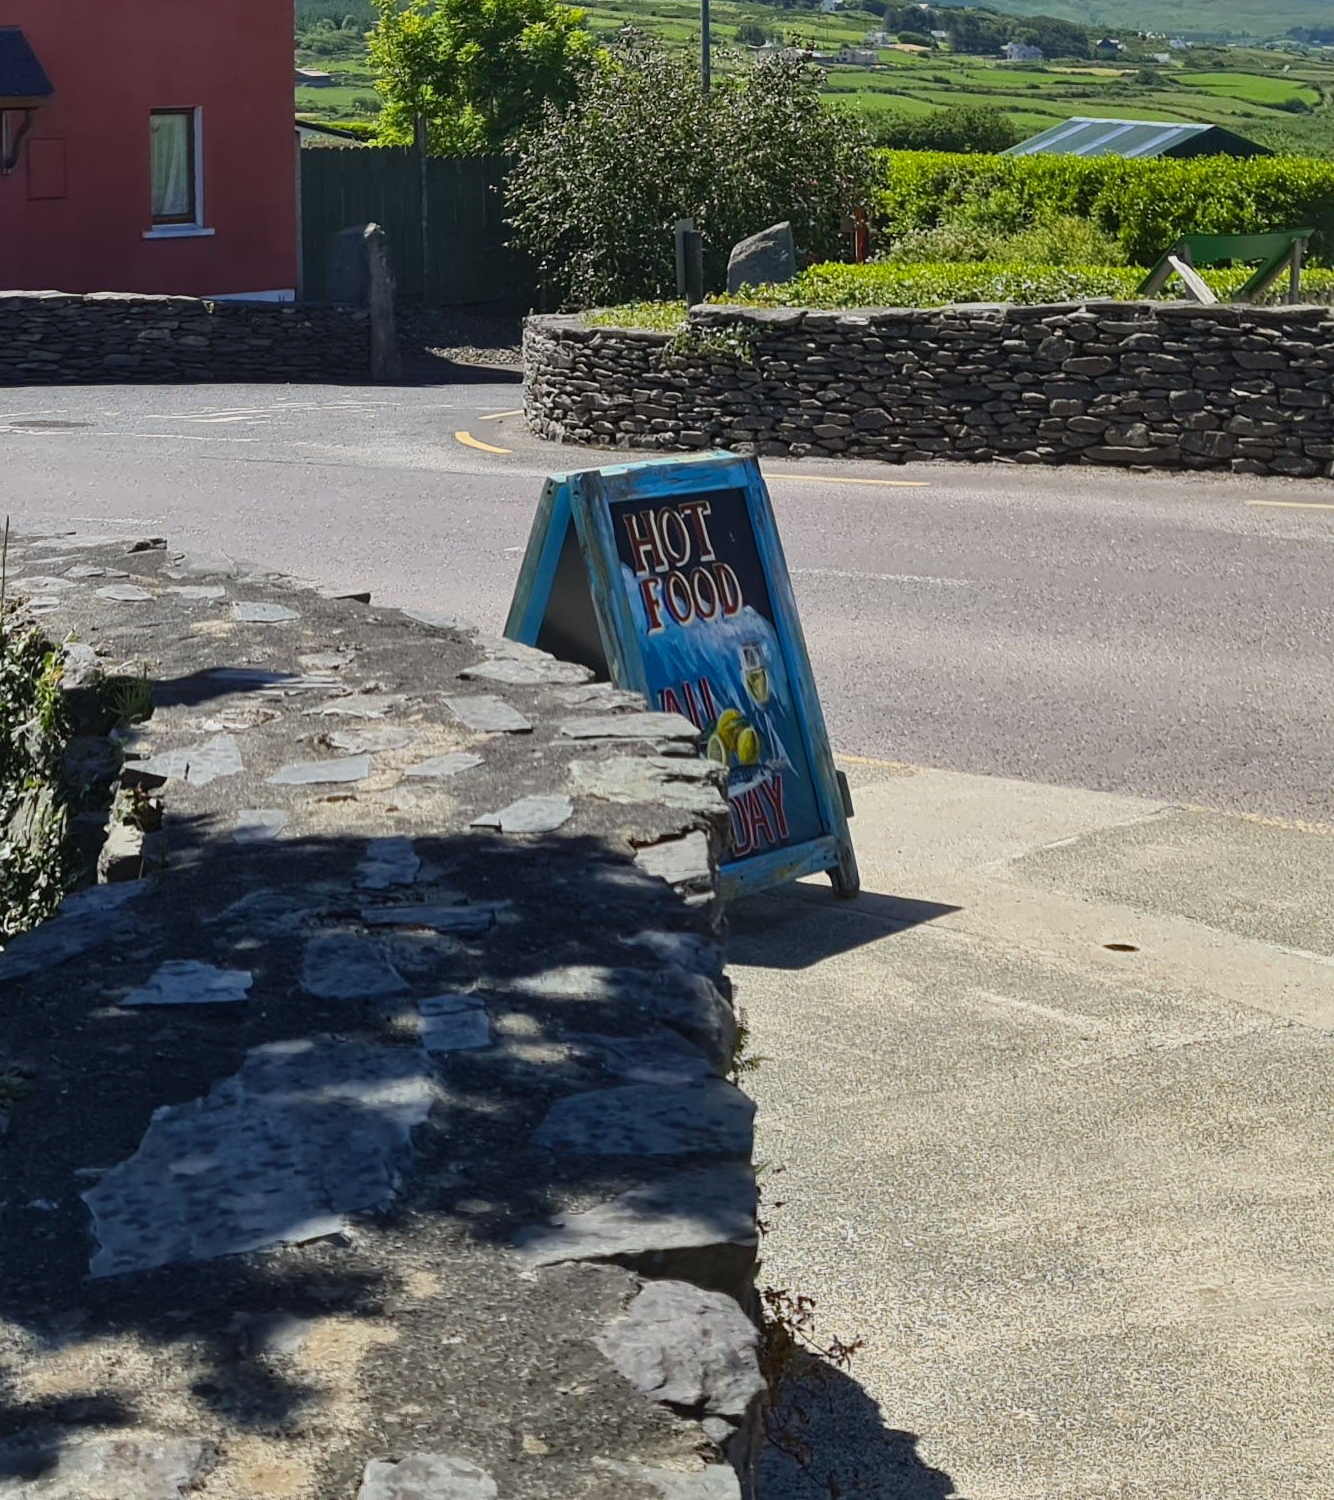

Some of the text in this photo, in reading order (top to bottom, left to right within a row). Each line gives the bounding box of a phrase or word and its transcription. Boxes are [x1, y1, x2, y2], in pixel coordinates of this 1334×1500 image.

[623, 500, 716, 576] HOT
[641, 563, 743, 635] FOOD
[731, 773, 789, 857] DAY
